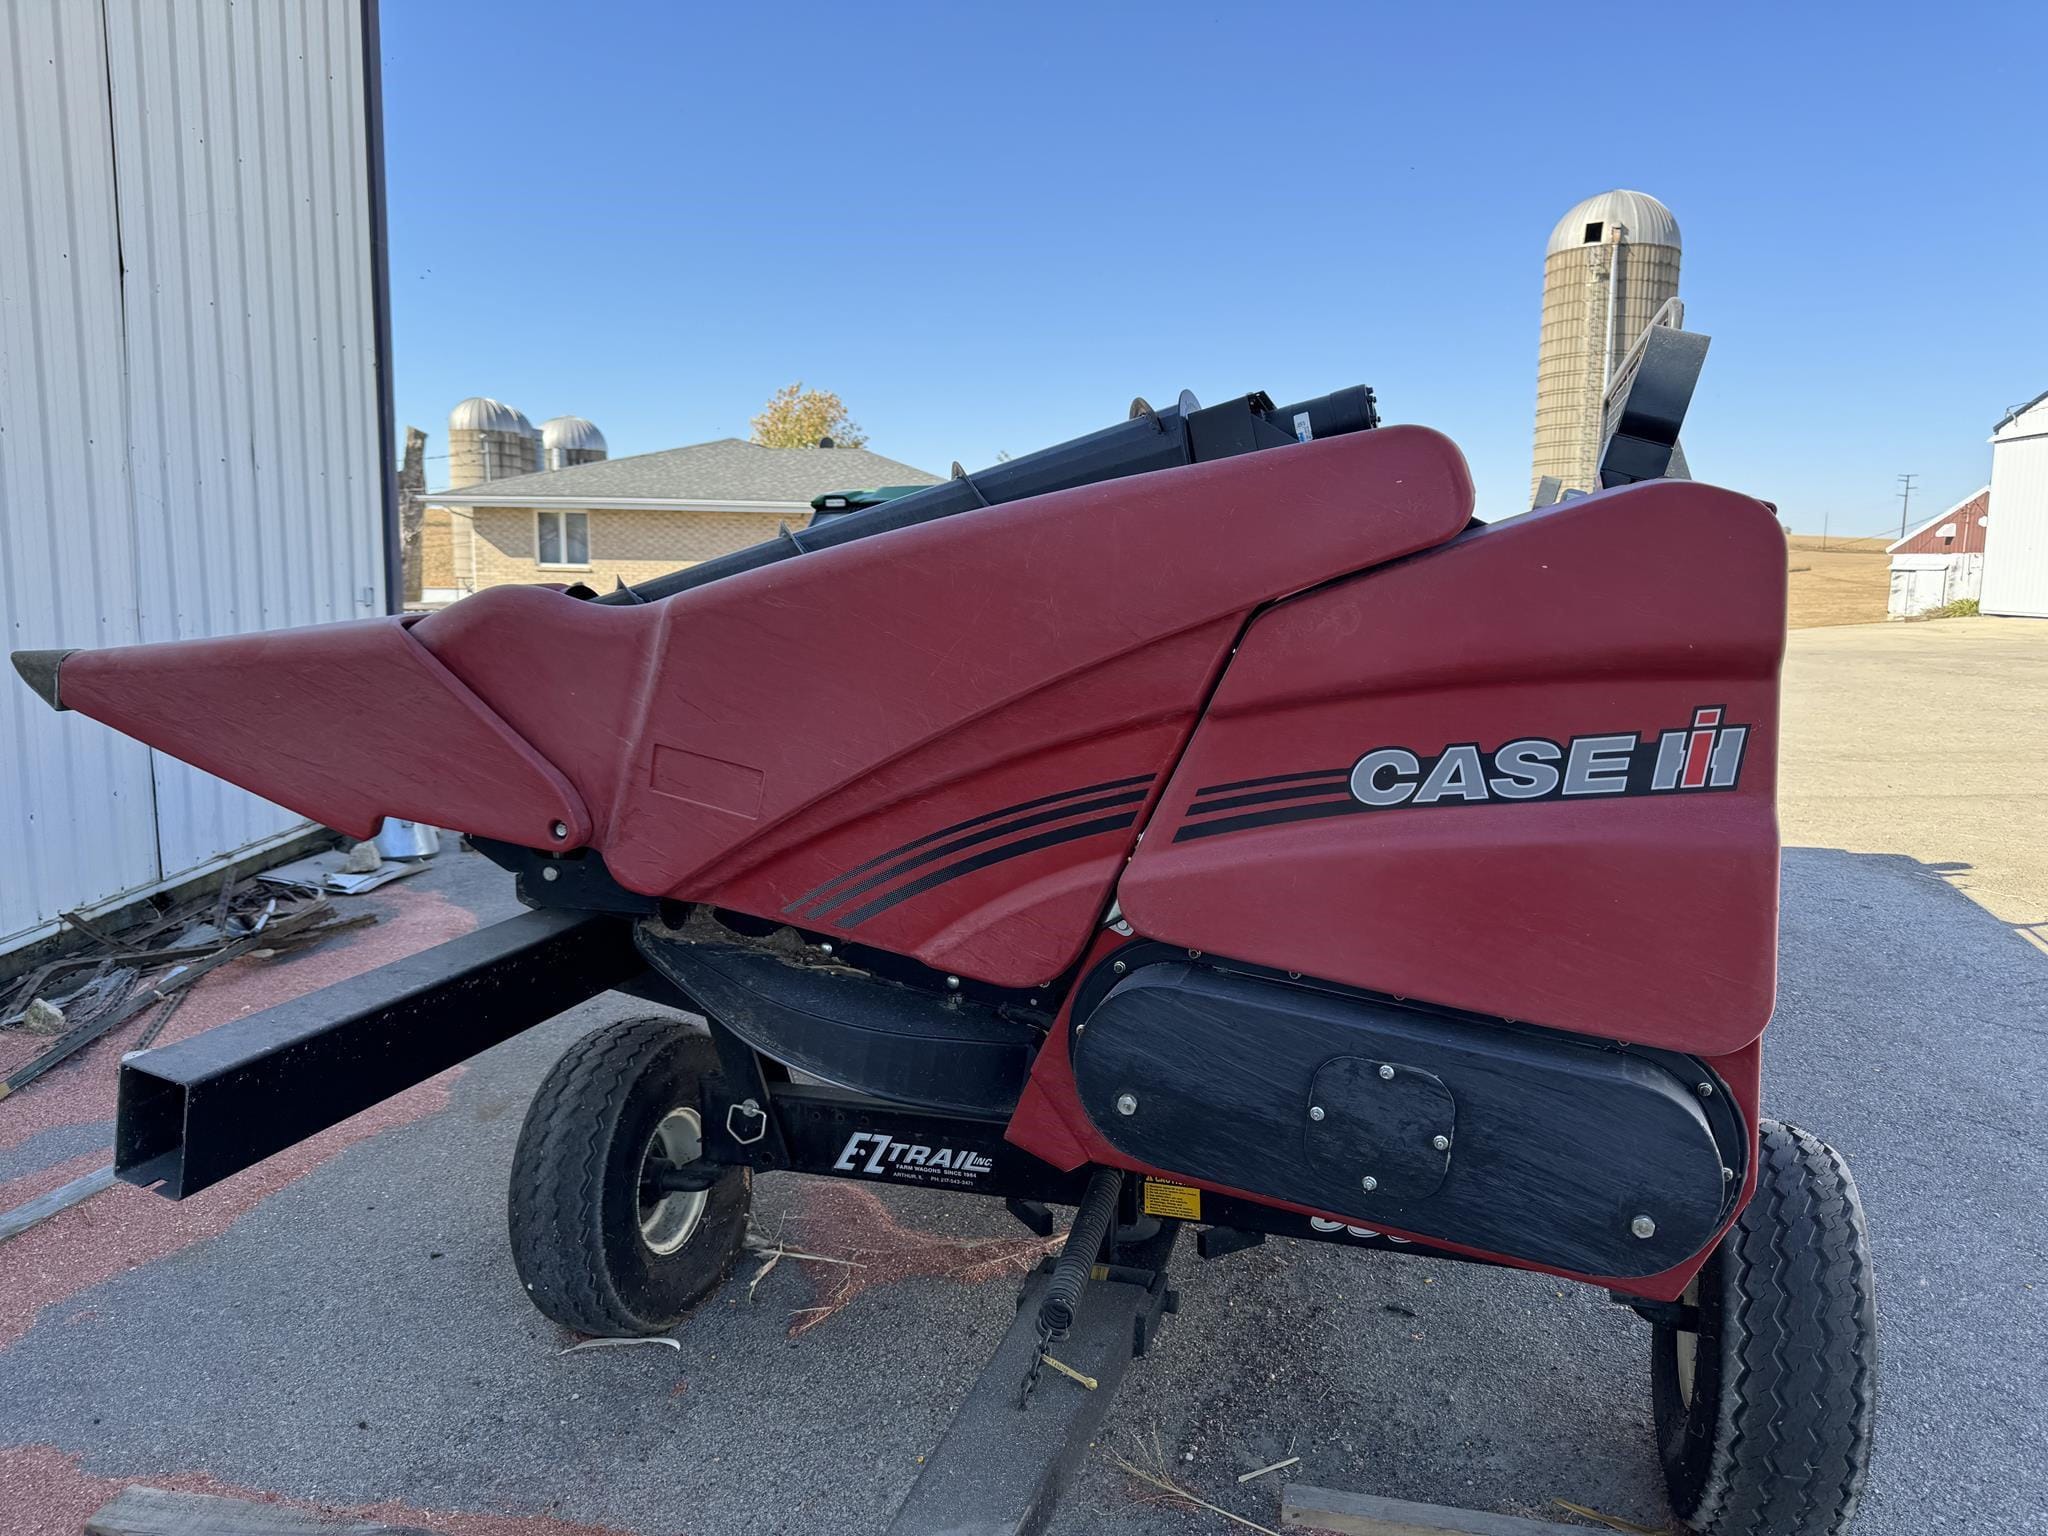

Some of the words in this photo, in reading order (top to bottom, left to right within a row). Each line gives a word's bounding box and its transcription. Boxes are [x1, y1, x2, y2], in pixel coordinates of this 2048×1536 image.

[1350, 734, 1637, 806] CASE
[887, 1142, 991, 1173] TRAIL
[914, 1166, 941, 1174] WAGONS
